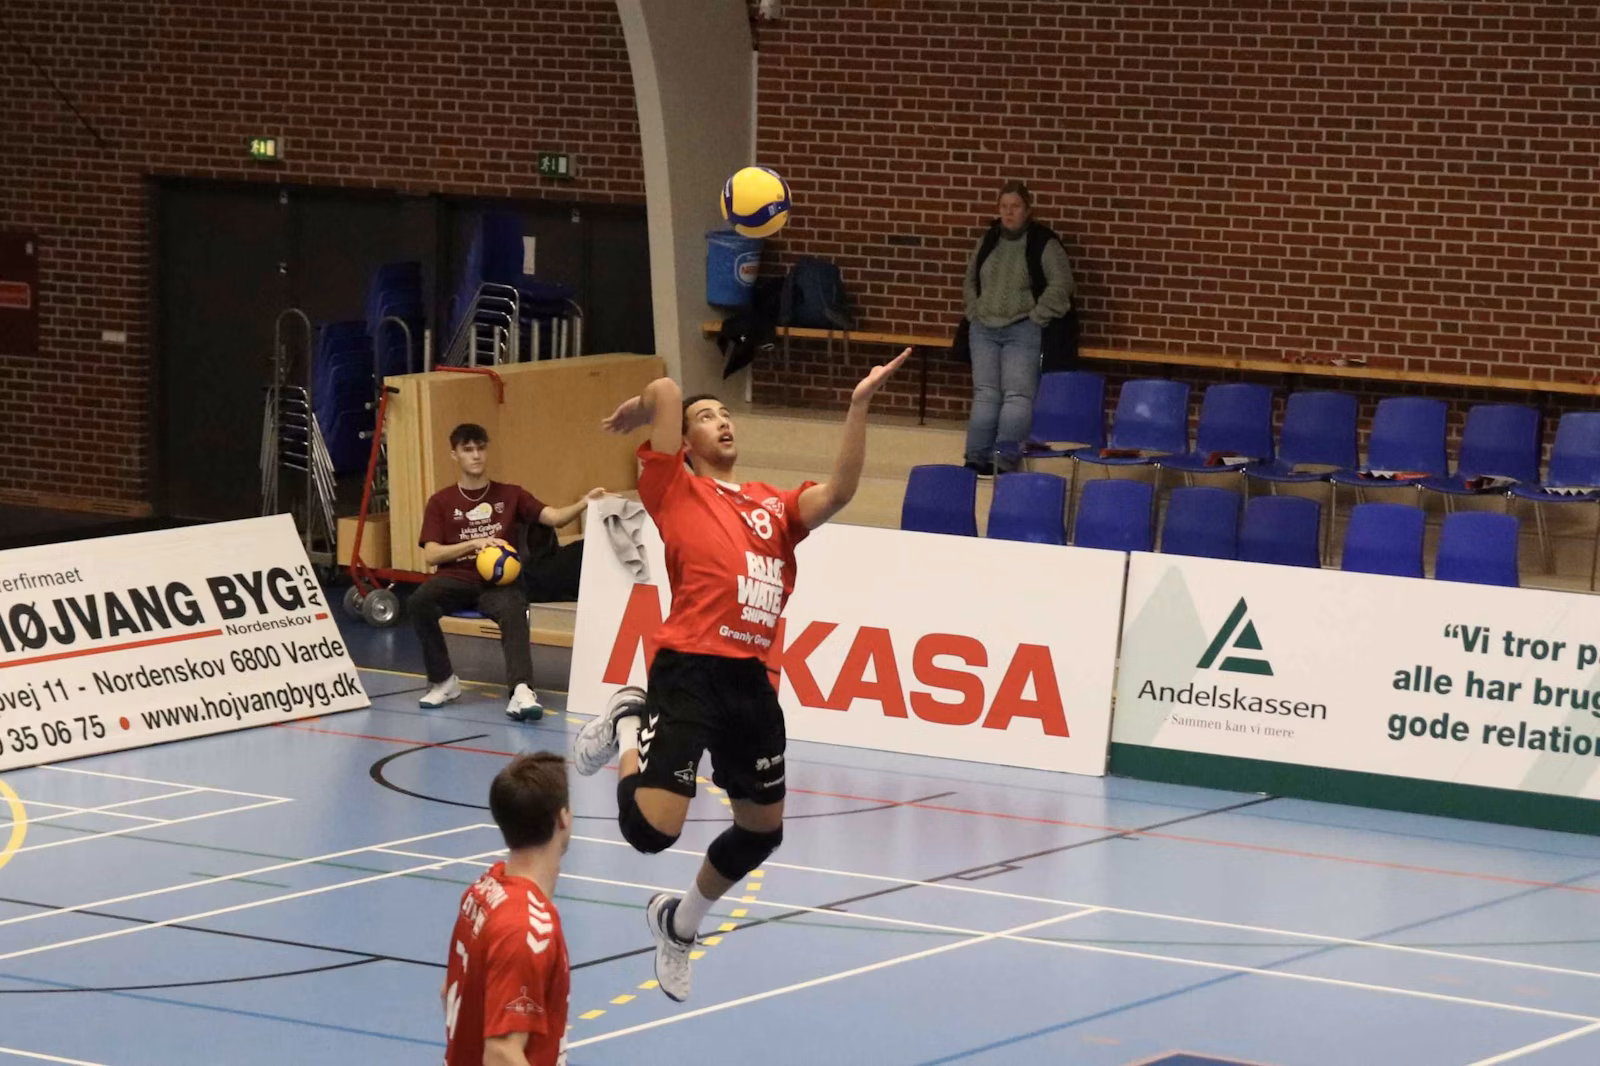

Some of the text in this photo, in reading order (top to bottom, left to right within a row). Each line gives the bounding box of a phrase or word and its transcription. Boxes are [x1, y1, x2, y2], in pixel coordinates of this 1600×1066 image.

[206, 567, 306, 620] BYG
[226, 614, 312, 636] Nordenskov
[719, 625, 754, 645] Granly
[43, 678, 69, 703] 11
[92, 657, 226, 696] Nordenskov
[230, 645, 281, 673] 6800
[281, 636, 345, 664] Varde
[1502, 631, 1566, 661] tror
[1577, 643, 1600, 670] p
[1137, 679, 1328, 720] Andelskassen
[1392, 665, 1453, 695] alle
[1465, 670, 1522, 702] har
[7, 725, 38, 752] 35
[41, 720, 72, 747] 06
[73, 714, 105, 741] 75
[141, 672, 361, 730] www.hojvangbyg.dk
[1171, 714, 1222, 731] Sammen
[1225, 719, 1247, 734] kan
[1250, 725, 1261, 735] vi
[1264, 727, 1295, 739] mere
[1388, 712, 1600, 757] gode relatio
